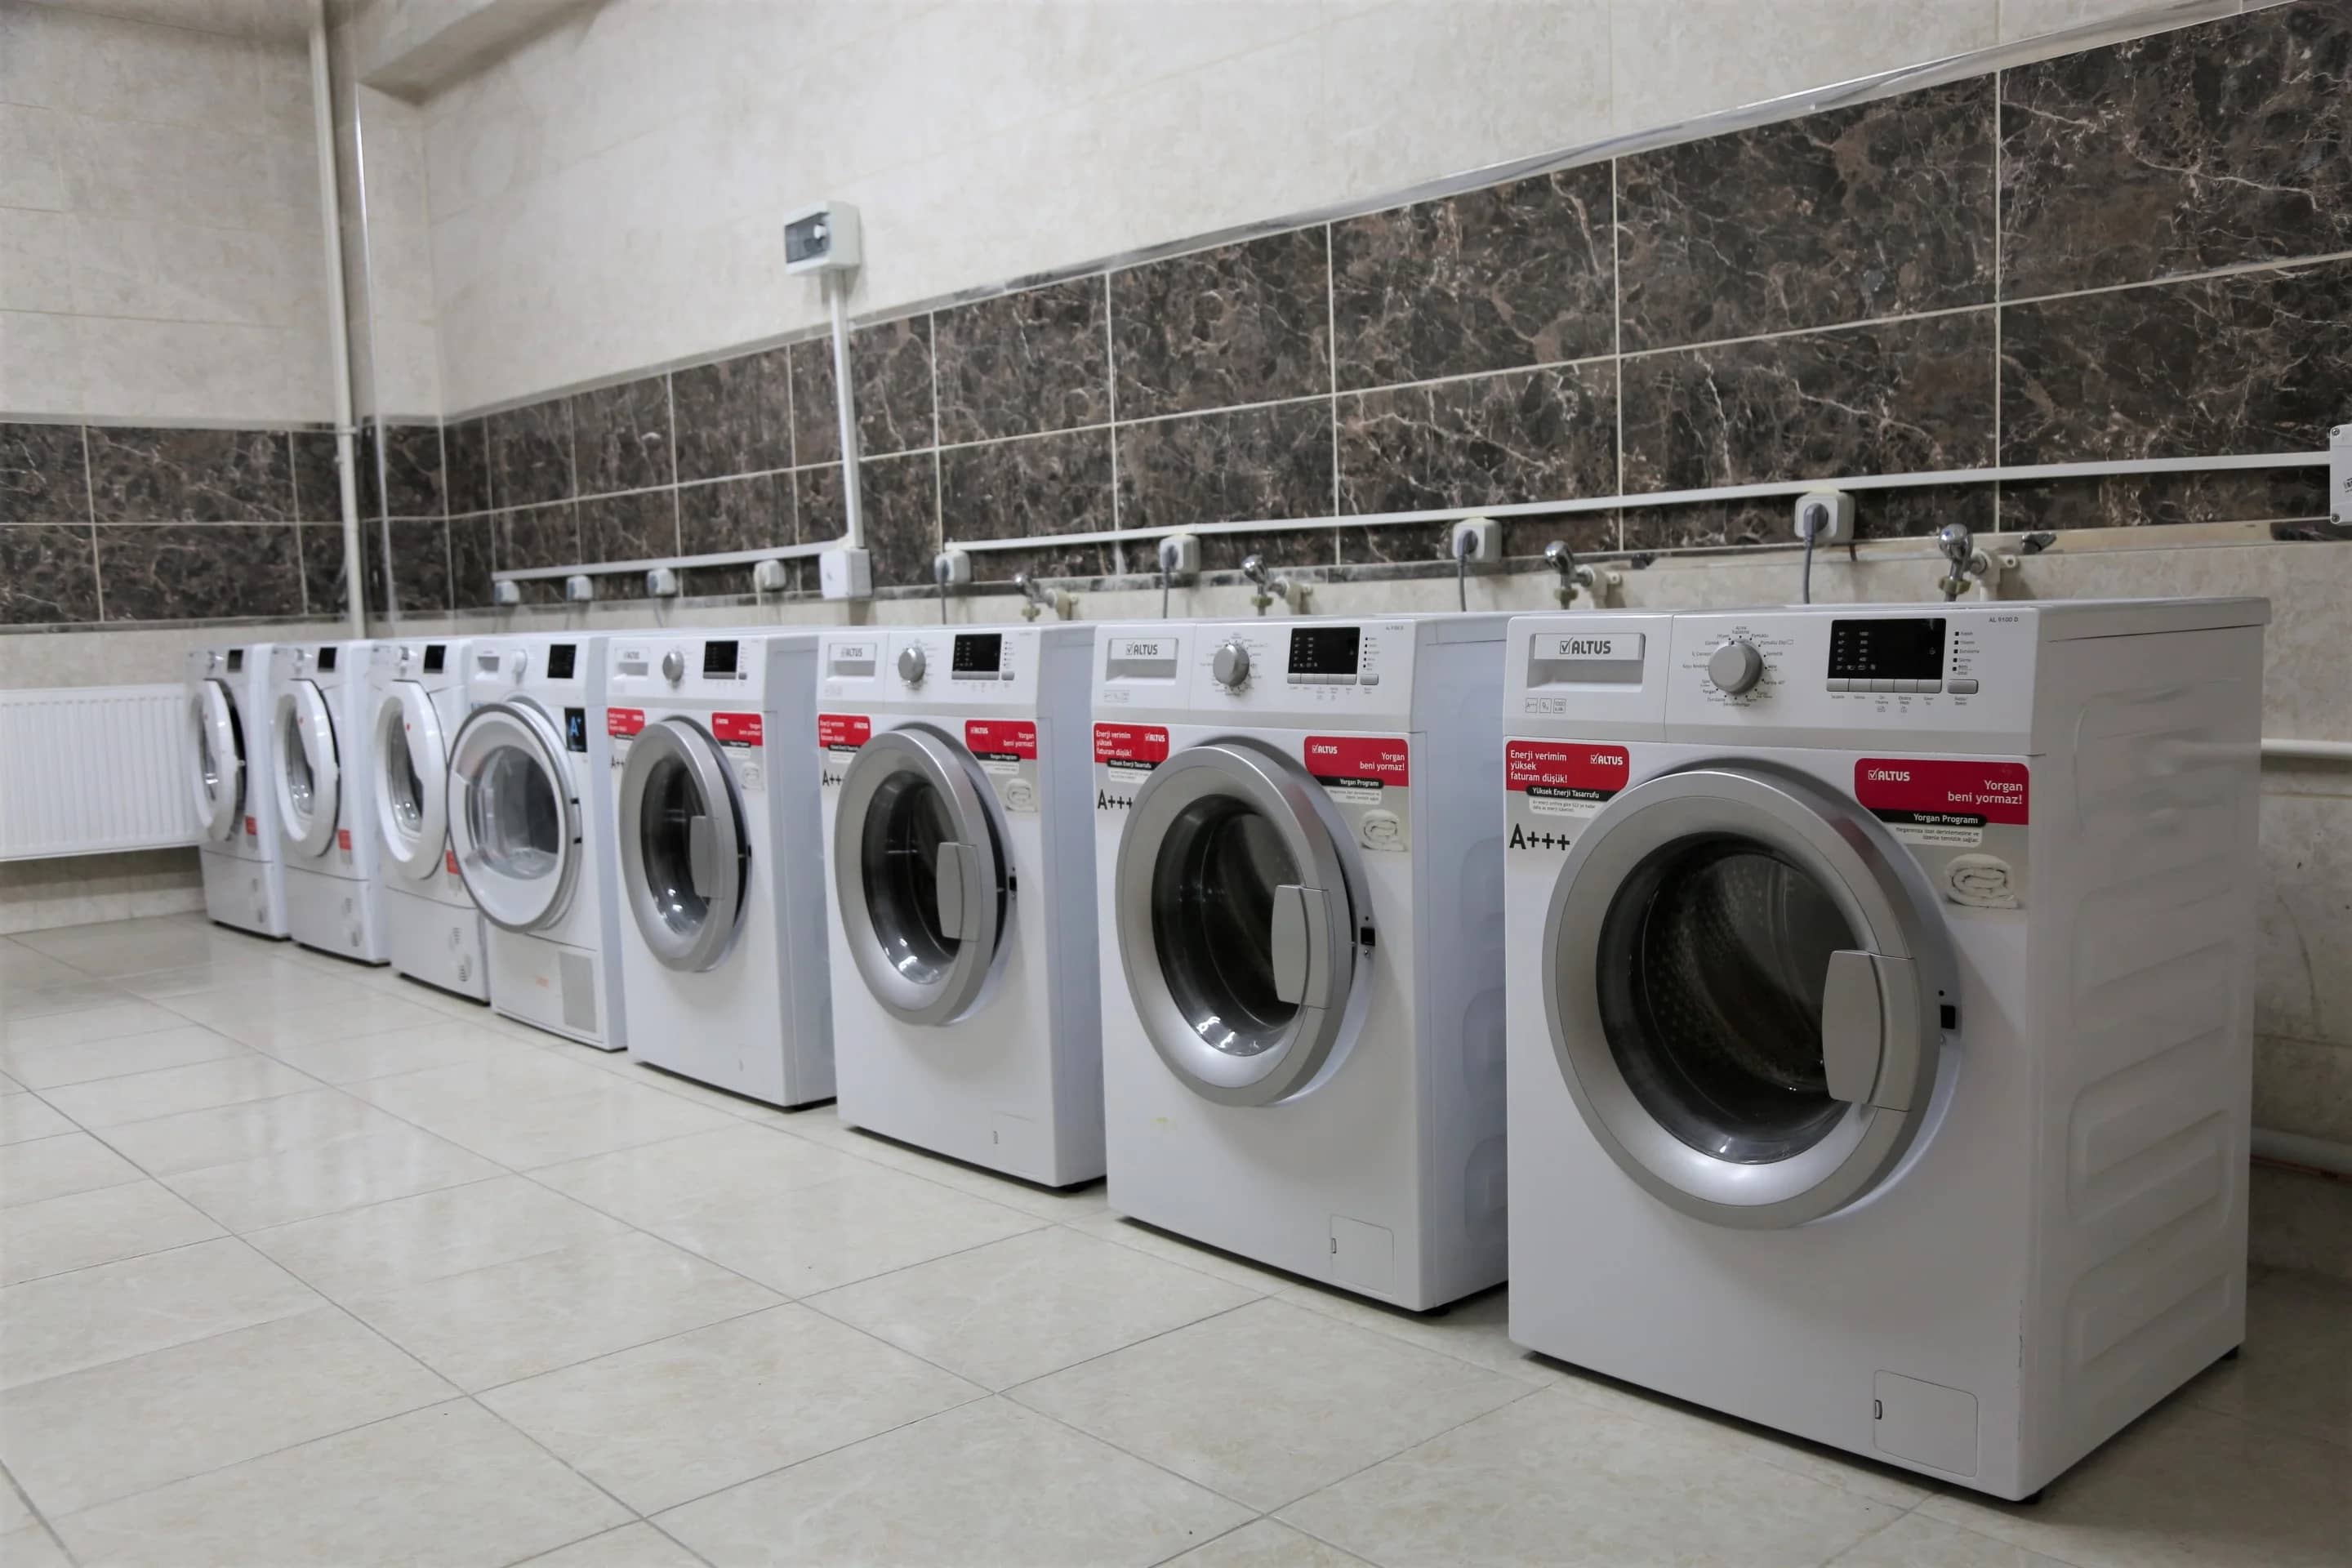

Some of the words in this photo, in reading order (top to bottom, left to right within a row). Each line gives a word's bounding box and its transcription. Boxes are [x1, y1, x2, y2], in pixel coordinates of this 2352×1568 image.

[1134, 644, 1159, 656] ALTUS
[1571, 640, 1611, 654] ALTUS
[1317, 745, 1338, 755] ALTUS
[1510, 750, 1533, 762] Enerji
[1535, 751, 1567, 761] verimim
[1381, 751, 1405, 763] Yorgan
[1597, 755, 1624, 765] ALTUS
[1360, 761, 1375, 769] beni
[1377, 763, 1405, 772] yormaz!
[1510, 760, 1536, 772] yüksek
[1510, 772, 1540, 782] faturam
[1542, 773, 1568, 785] düşük!
[1878, 770, 1910, 782] ALTUS
[1533, 786, 1552, 795] Yüksek
[1553, 788, 1571, 798] Enerji
[1572, 791, 1600, 799] Tasarrufu
[1984, 780, 2023, 793] Yorgan
[1948, 791, 1972, 803] beni
[1976, 794, 2023, 805] yormaz!
[1913, 813, 1940, 823] Yorgan
[1942, 814, 1979, 826] Programı
[1509, 823, 1570, 851] A+++
